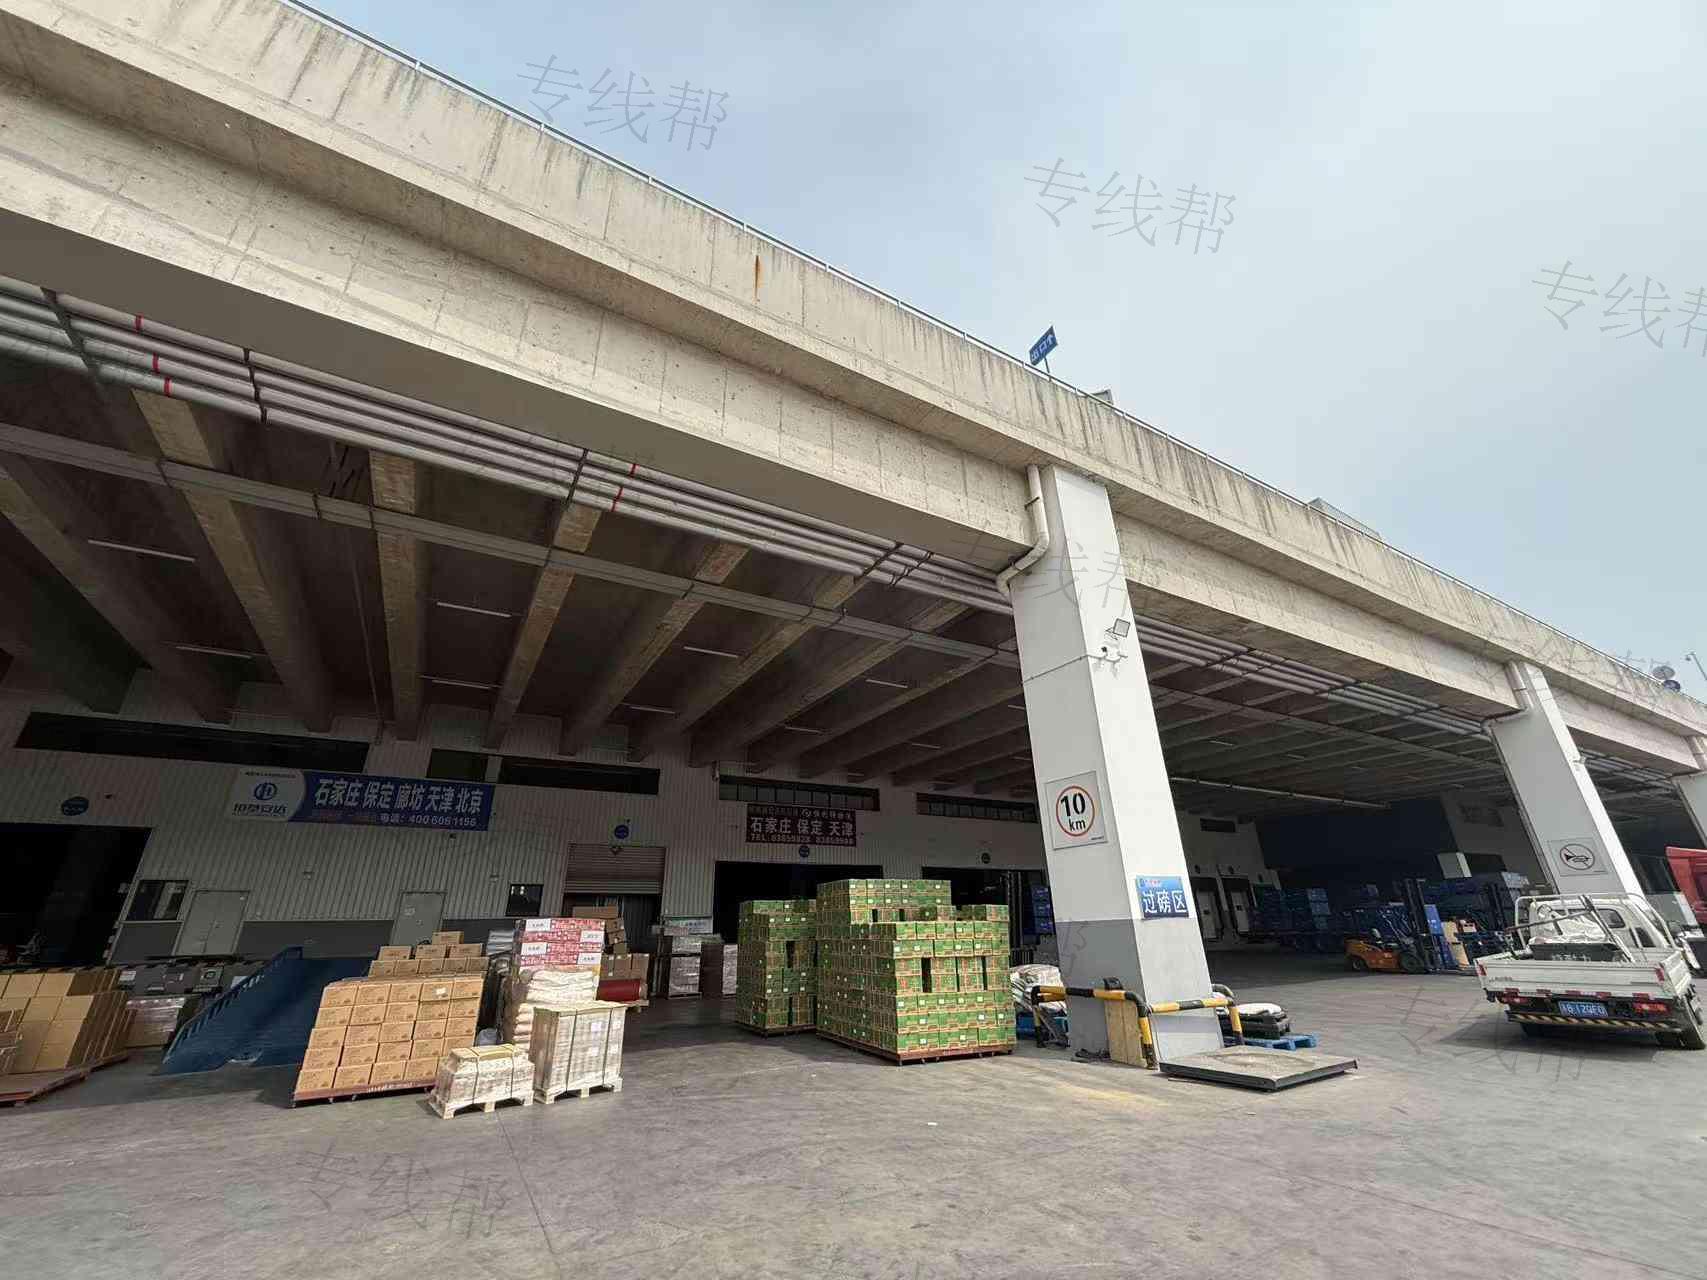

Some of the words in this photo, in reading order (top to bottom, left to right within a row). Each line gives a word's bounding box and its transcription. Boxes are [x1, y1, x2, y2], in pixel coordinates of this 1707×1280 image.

[314, 778, 361, 807] 石家庄
[363, 781, 395, 809] 保定
[397, 784, 426, 811] 廊坊
[427, 785, 455, 814] 天津
[455, 787, 484, 815] 北京
[1060, 793, 1086, 817] 10
[409, 814, 430, 825] 400
[751, 817, 791, 834] 石家庄
[797, 819, 822, 835] 保定
[829, 821, 853, 837] 天津
[1068, 818, 1086, 831] km
[1143, 890, 1187, 913] 过磅区
